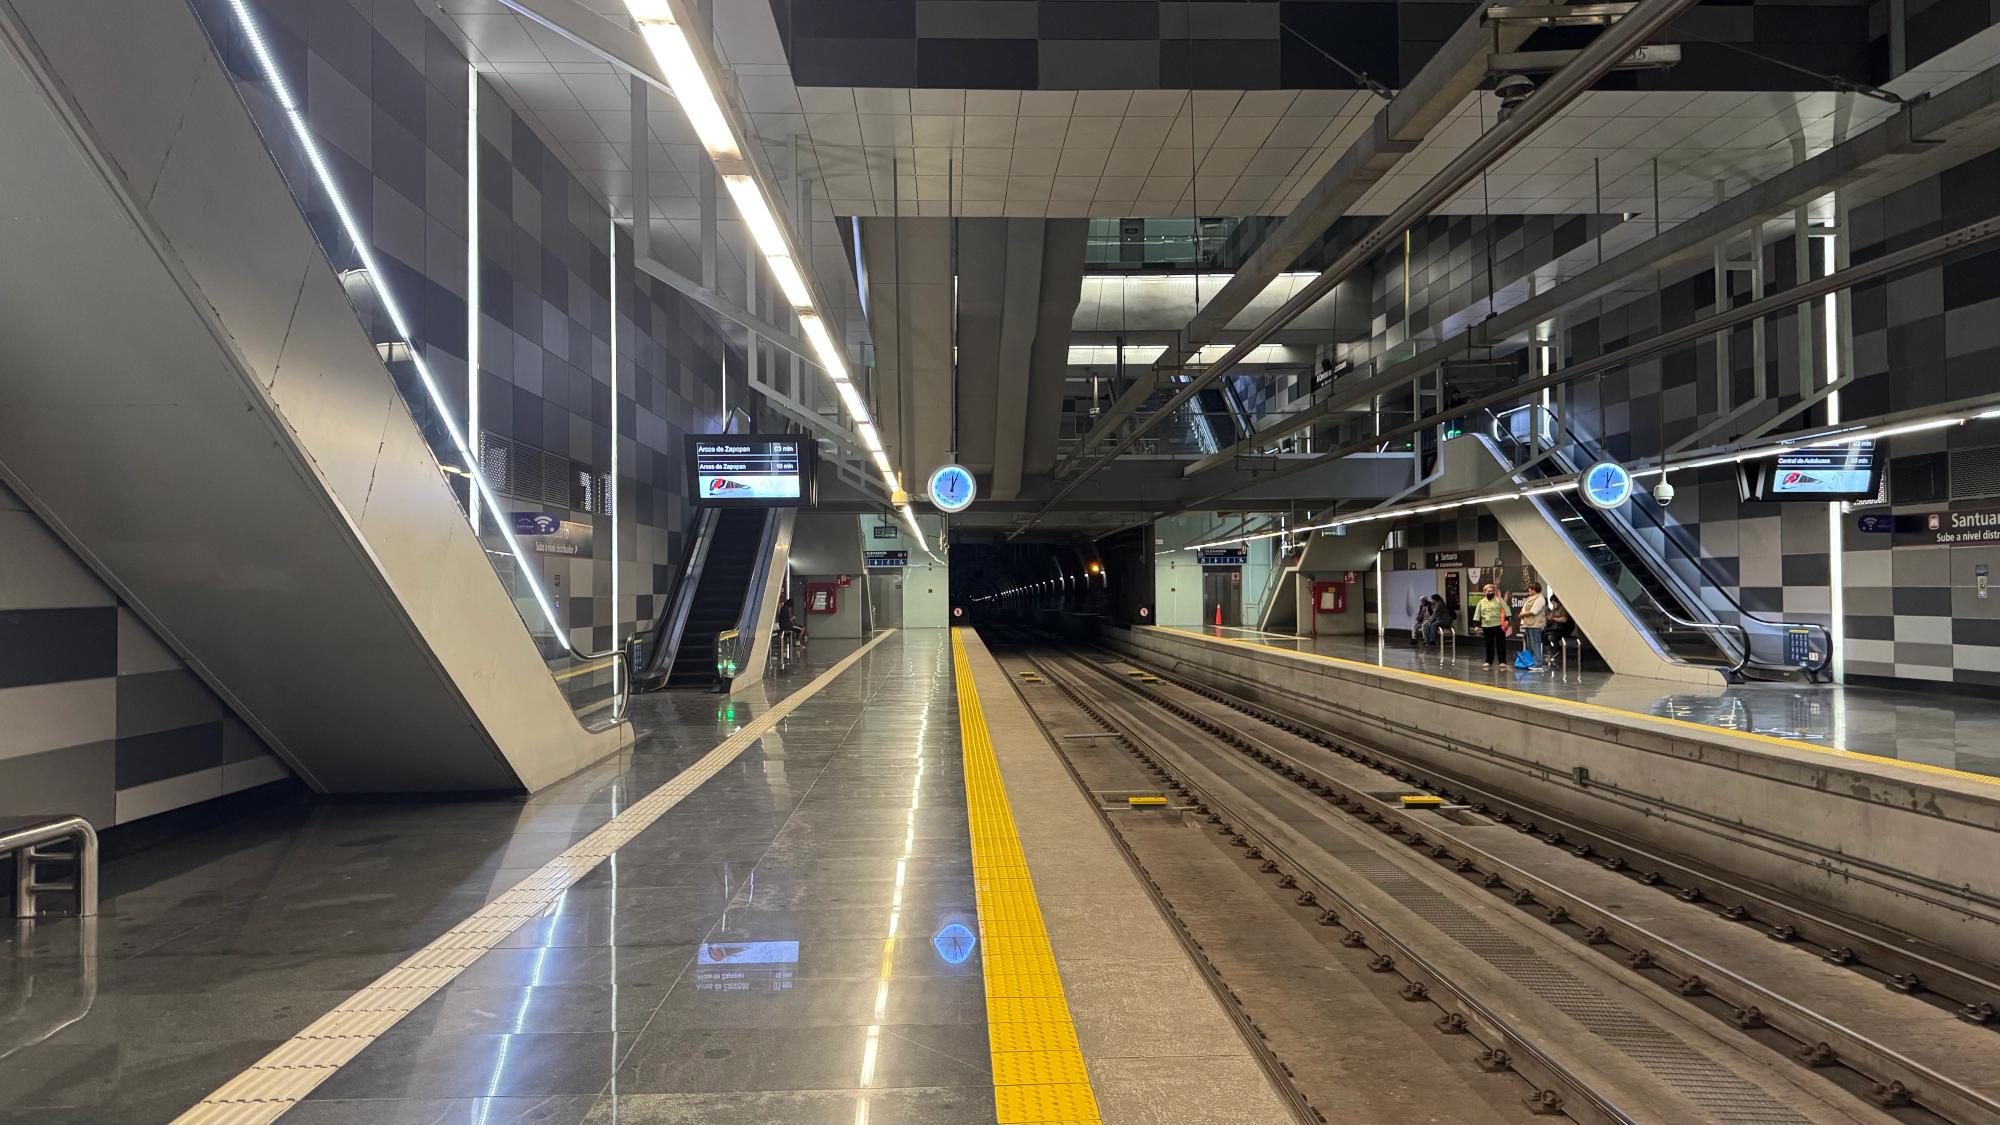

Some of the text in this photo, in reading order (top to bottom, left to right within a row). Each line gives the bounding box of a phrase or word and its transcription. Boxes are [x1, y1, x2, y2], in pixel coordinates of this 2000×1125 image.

[723, 463, 747, 471] Zapopan
[1936, 532, 1955, 542] Sube
[1962, 531, 1981, 541] nivel
